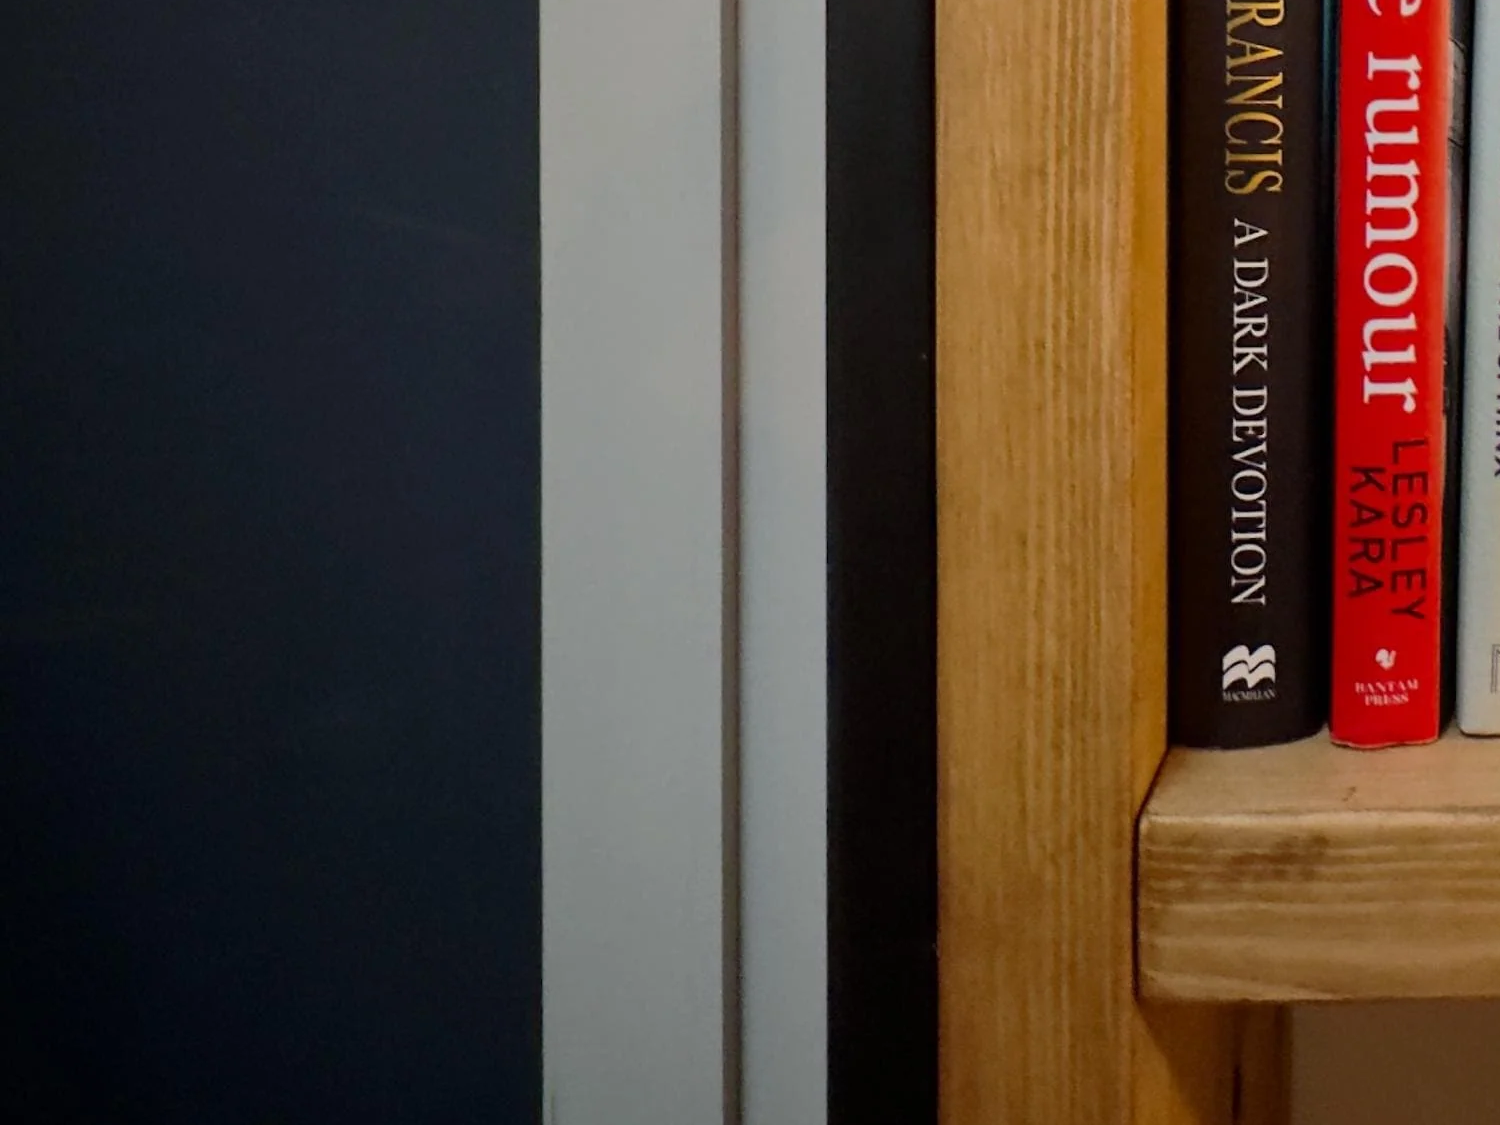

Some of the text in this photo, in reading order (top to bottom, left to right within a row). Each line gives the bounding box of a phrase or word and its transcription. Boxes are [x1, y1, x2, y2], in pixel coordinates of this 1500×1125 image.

[1361, 51, 1422, 413] rumour
[1230, 217, 1269, 606] A DARK DEVOTION
[1347, 466, 1386, 599] KARA
[1389, 437, 1429, 621] LESLEY
[1354, 678, 1420, 695] BANTAM
[1364, 693, 1410, 707] PRESS
